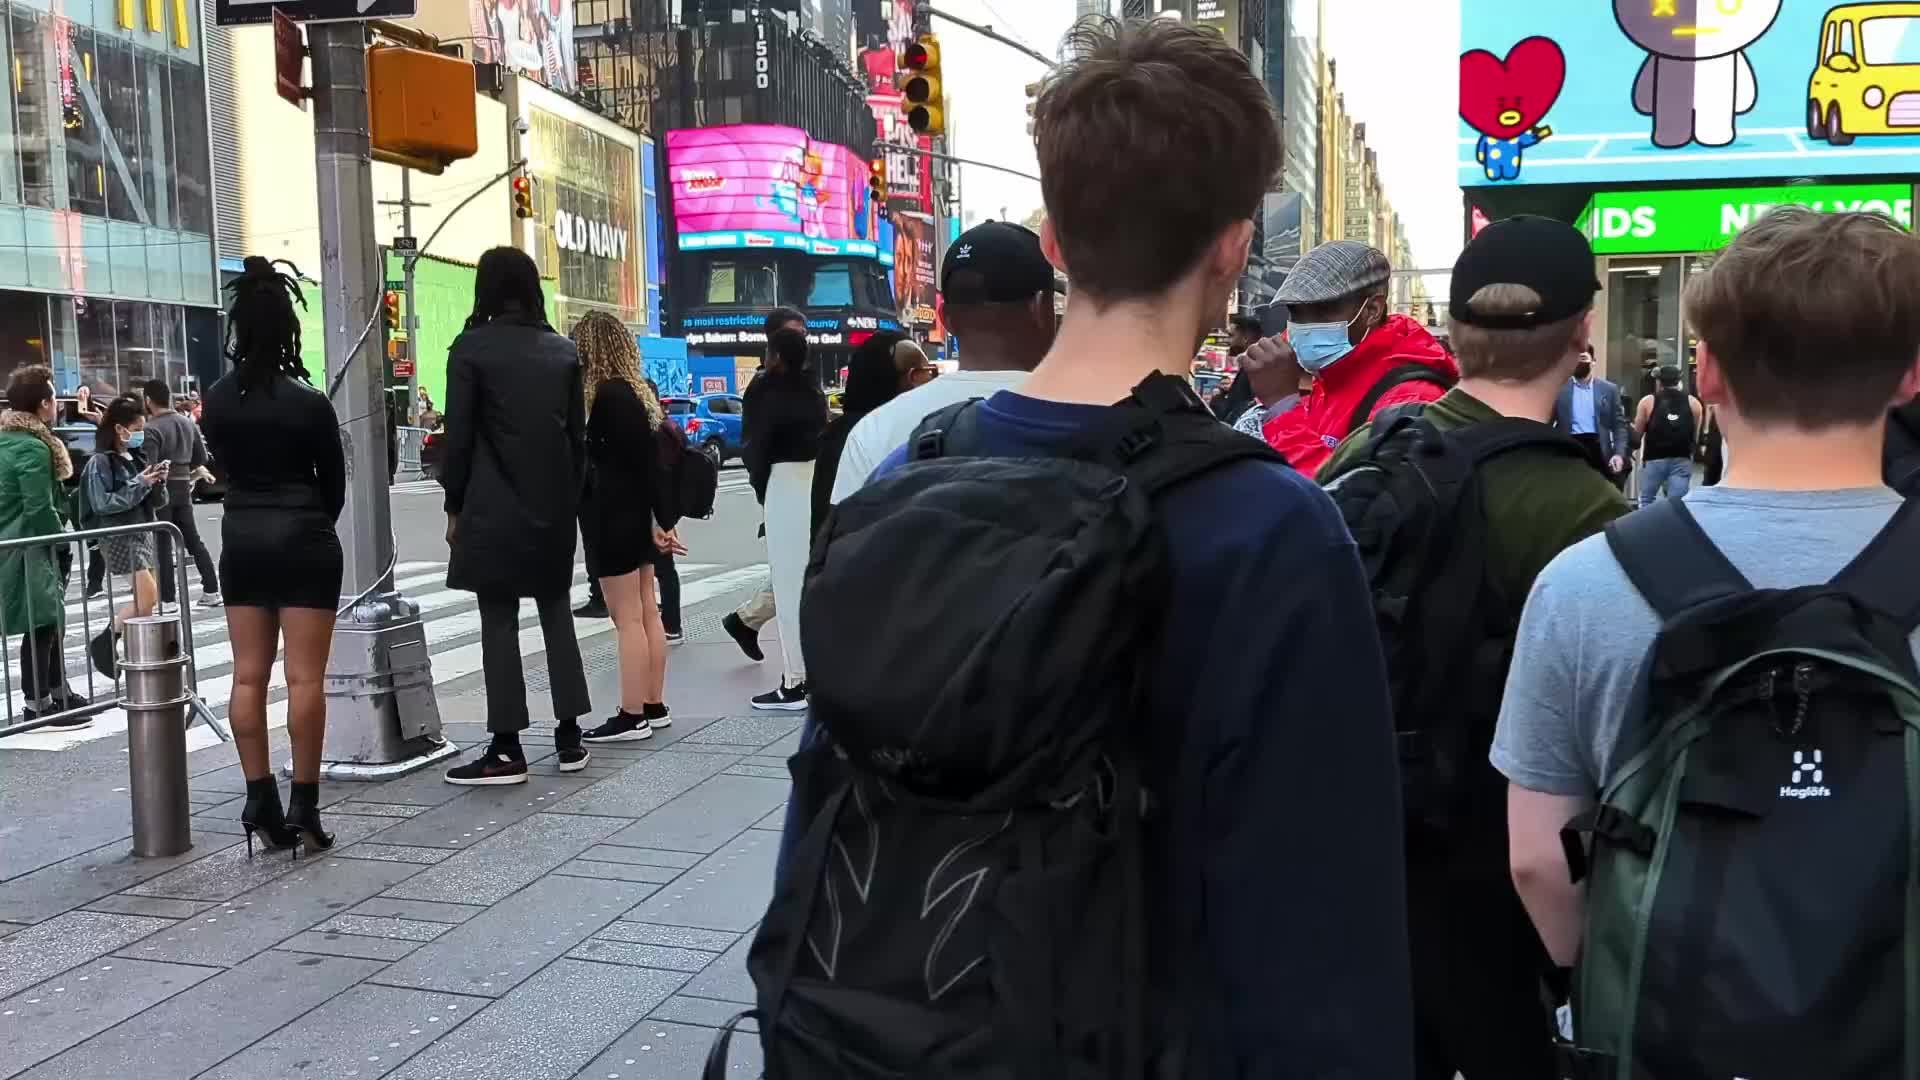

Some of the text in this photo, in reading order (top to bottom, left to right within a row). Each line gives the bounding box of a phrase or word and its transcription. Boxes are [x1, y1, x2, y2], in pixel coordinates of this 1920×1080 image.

[755, 24, 769, 89] 1500
[555, 209, 627, 262] OLD NAVY
[716, 315, 766, 326] restrictive
[1780, 786, 1831, 799] Haglöfs
